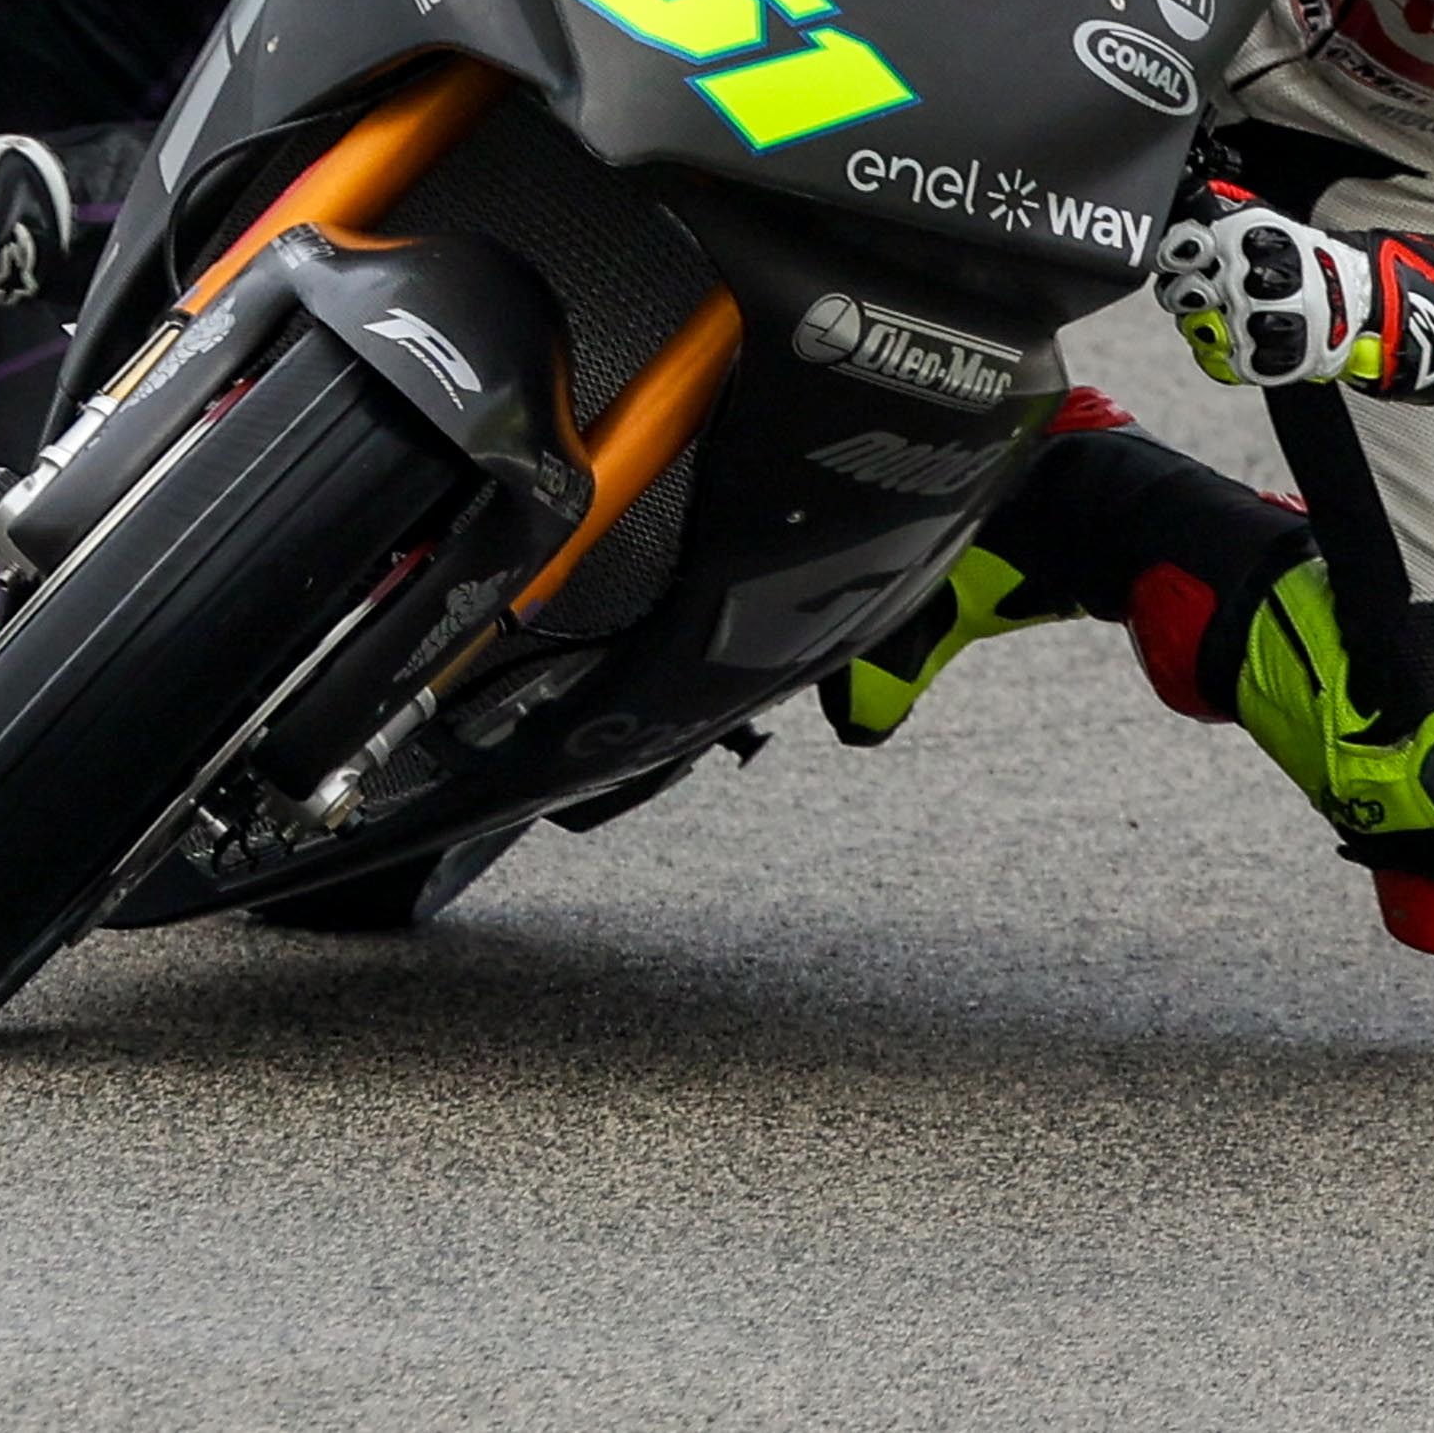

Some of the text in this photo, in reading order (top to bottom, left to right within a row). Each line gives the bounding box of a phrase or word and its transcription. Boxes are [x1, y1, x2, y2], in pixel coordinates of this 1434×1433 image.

[1096, 35, 1182, 101] COMAL
[845, 148, 1154, 266] enel way
